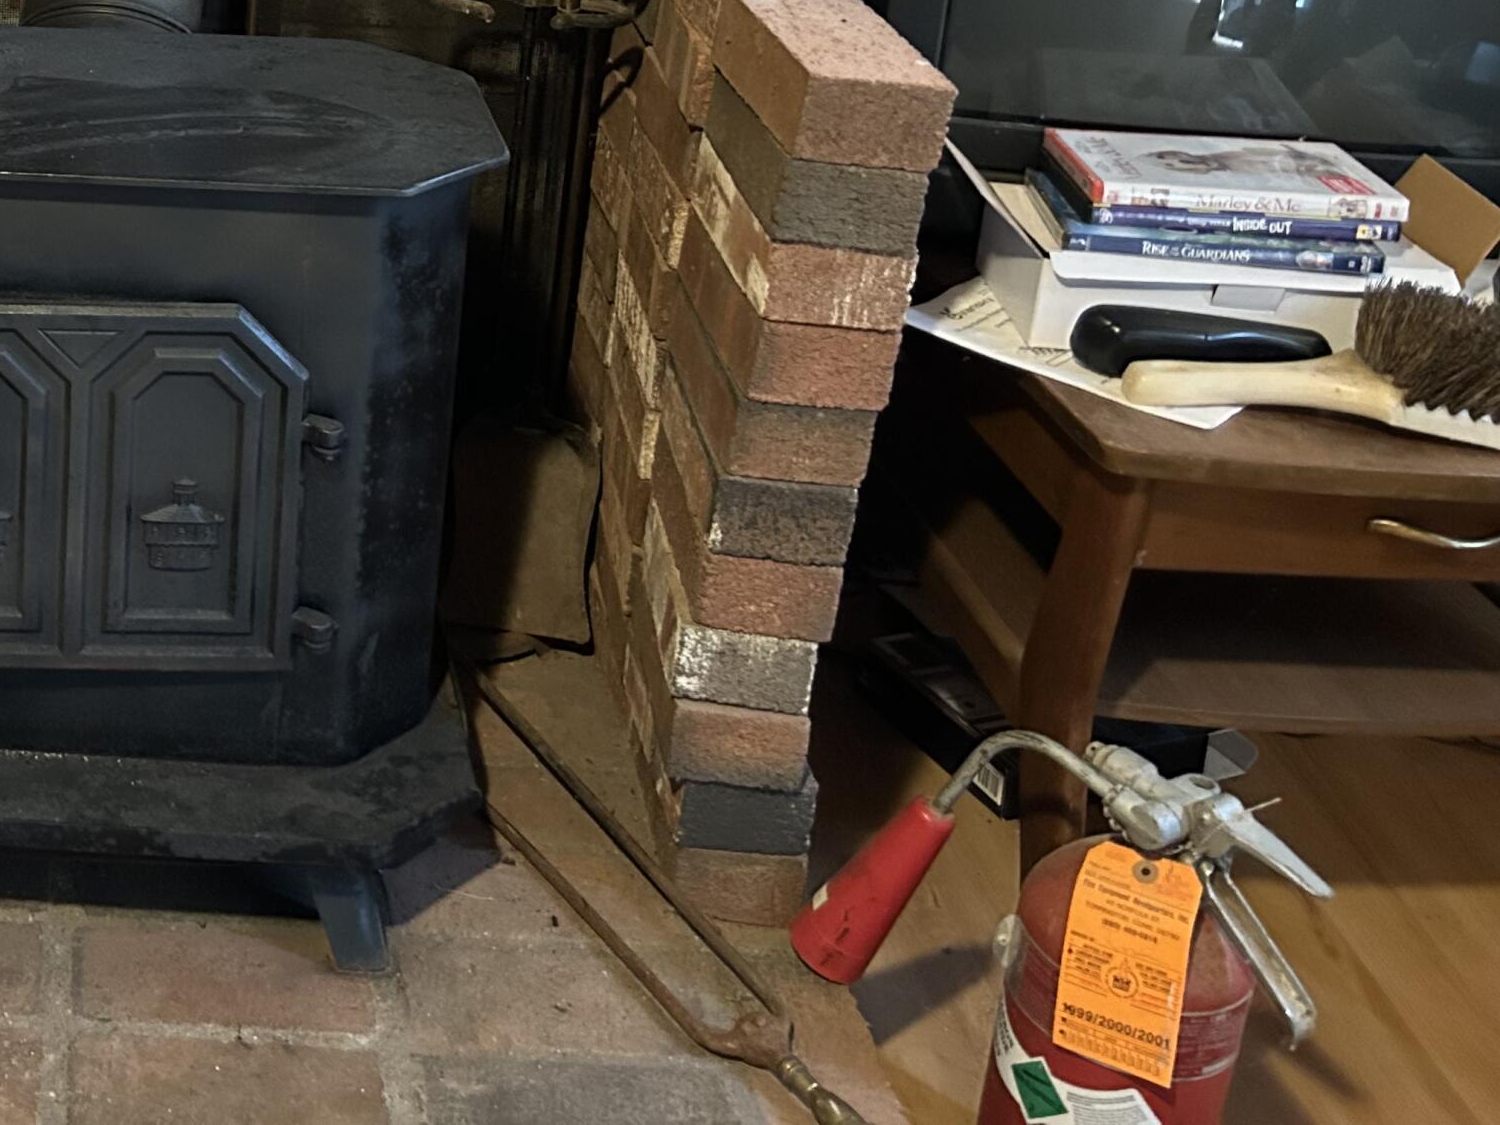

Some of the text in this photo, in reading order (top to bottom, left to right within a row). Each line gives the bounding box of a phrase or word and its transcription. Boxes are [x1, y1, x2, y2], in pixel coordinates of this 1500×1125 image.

[1195, 193, 1250, 211] Marley
[1254, 196, 1271, 210] &
[1232, 216, 1268, 232] INSIDE
[1269, 221, 1293, 235] OUT
[1141, 240, 1169, 256] RISE
[1181, 245, 1250, 263] GUARDIANS
